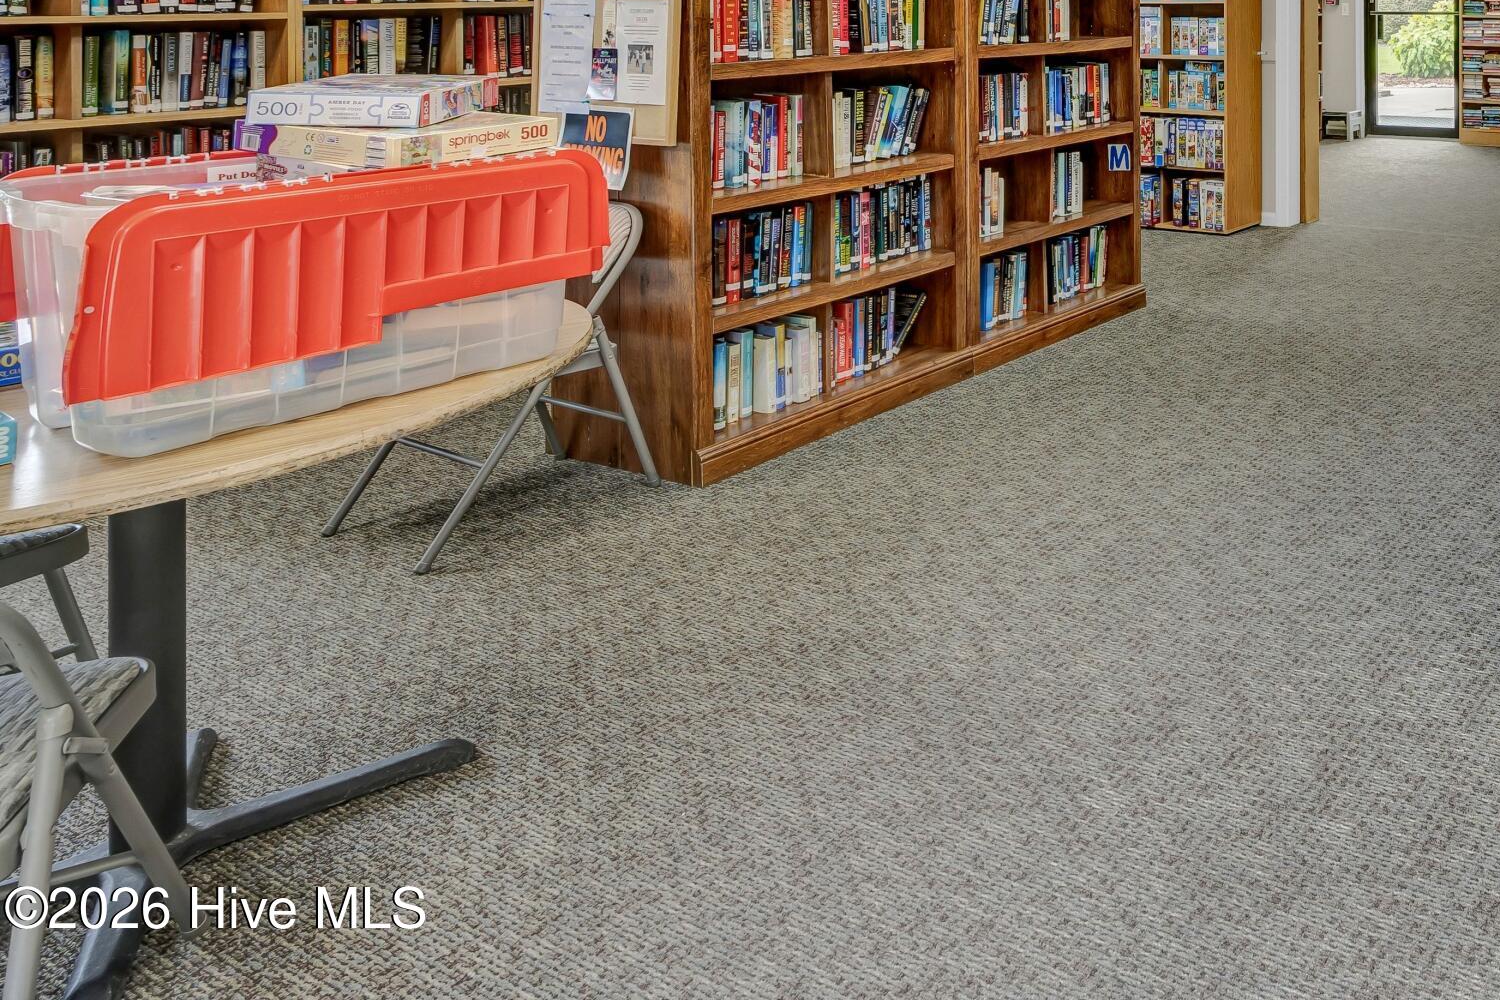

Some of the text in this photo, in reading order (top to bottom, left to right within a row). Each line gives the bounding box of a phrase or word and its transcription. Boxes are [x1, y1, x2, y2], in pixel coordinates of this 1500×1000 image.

[385, 21, 394, 43] Purity
[256, 102, 298, 117] 500
[856, 101, 864, 124] DESCENT
[448, 127, 511, 148] springbok
[520, 124, 548, 140] 500
[585, 115, 607, 142] NO
[1110, 145, 1130, 170] M
[218, 173, 237, 181] Put
